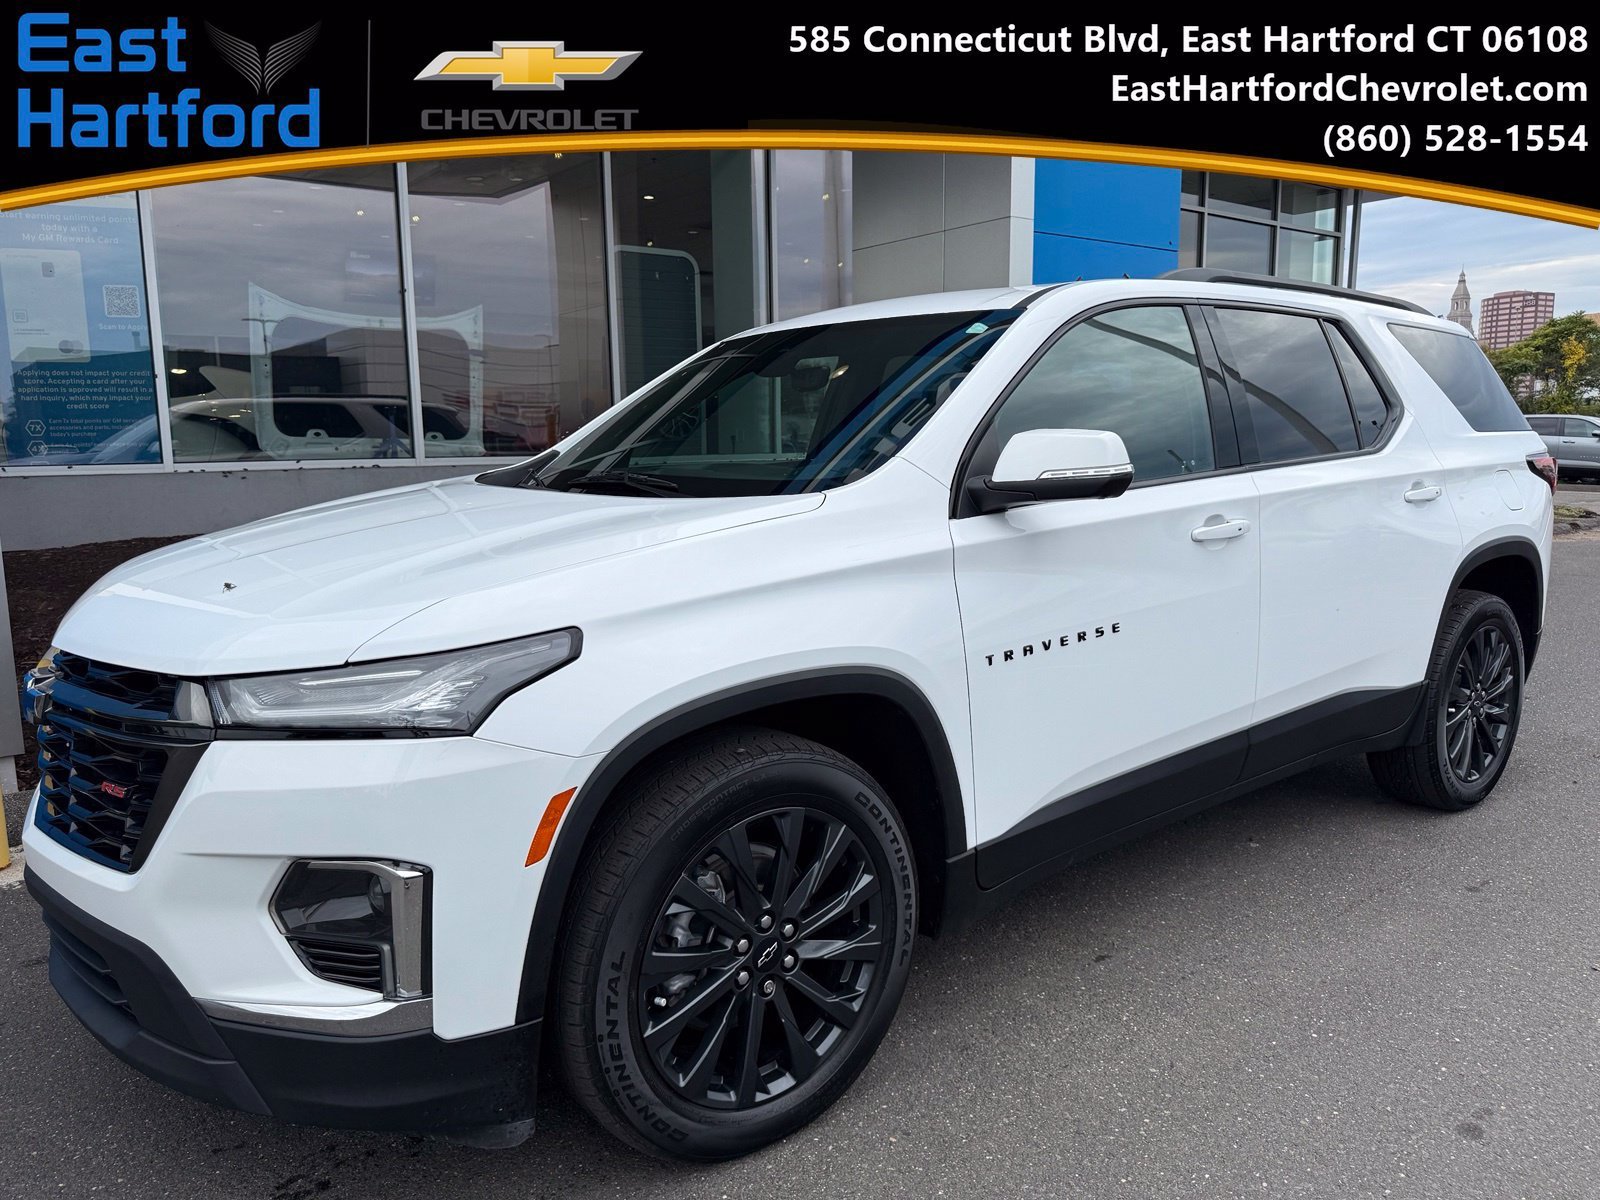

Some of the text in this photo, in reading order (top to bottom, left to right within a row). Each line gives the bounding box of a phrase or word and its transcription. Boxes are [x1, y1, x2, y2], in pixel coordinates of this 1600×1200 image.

[25, 213, 60, 221] earning
[63, 214, 106, 223] unlimited
[41, 224, 67, 232] today
[70, 224, 90, 232] with
[22, 233, 119, 244] My GM Rewards Card
[985, 622, 1121, 666] TRAVERSE
[101, 781, 128, 798] RS
[854, 791, 913, 967] CONTINENTAL
[605, 951, 689, 1143] CONTINENTAL
